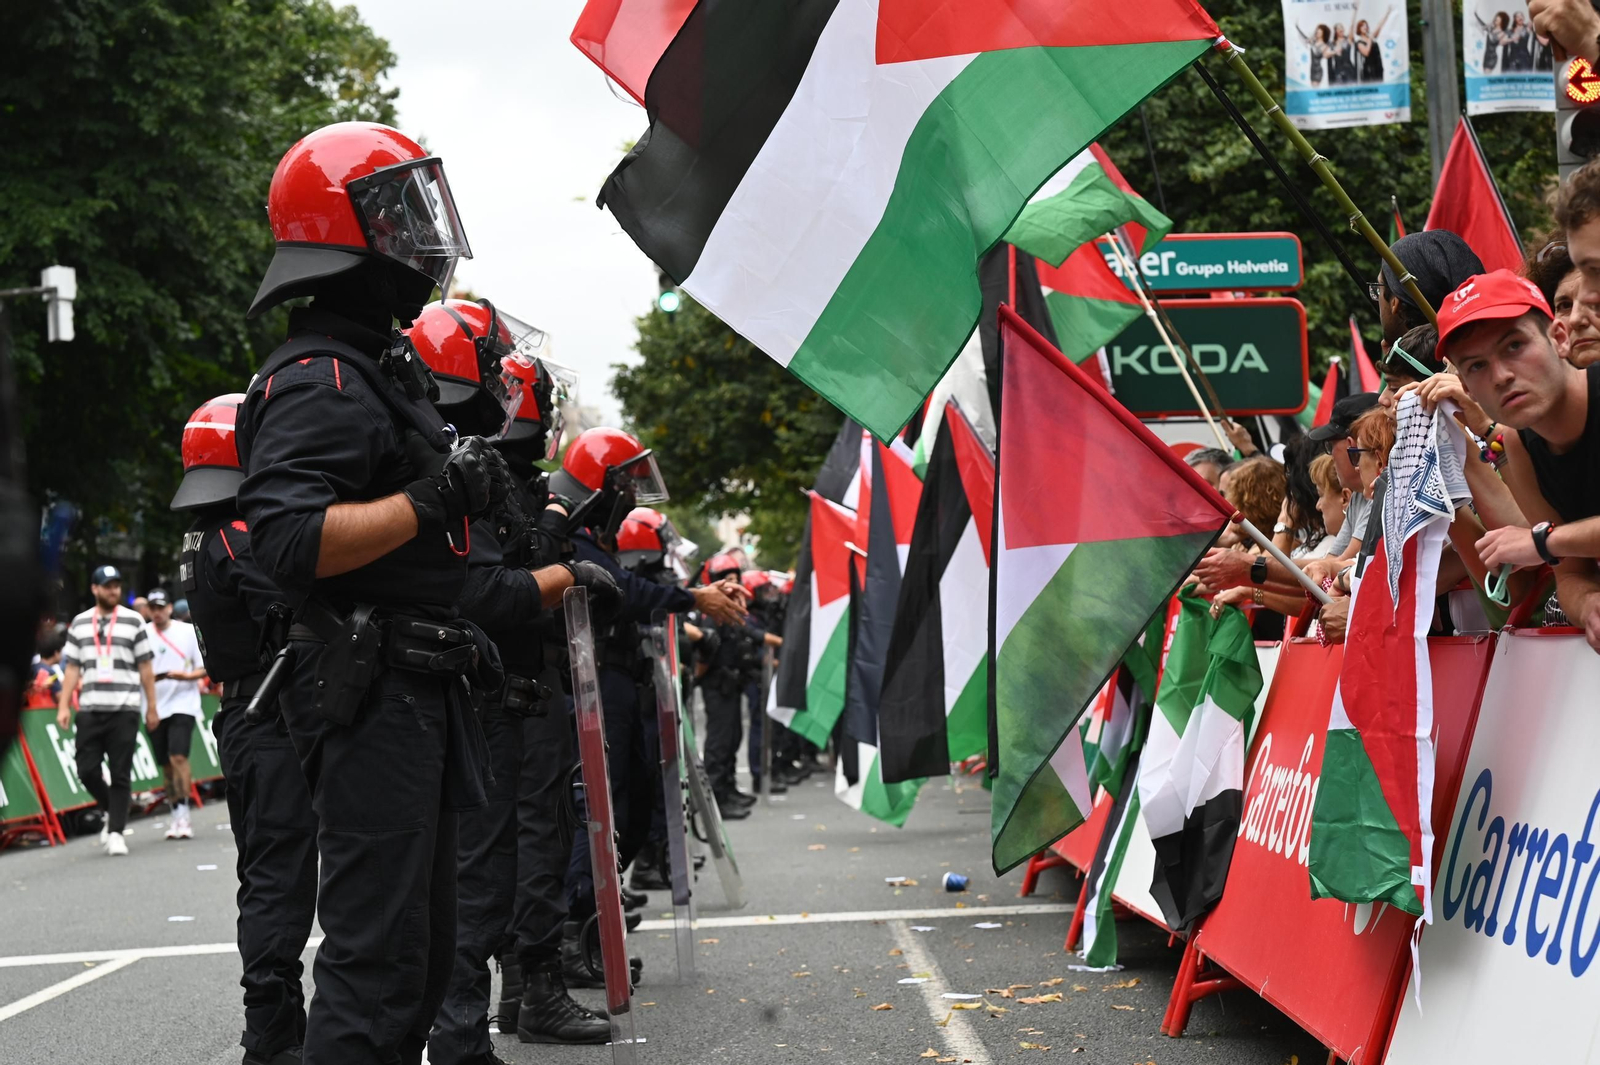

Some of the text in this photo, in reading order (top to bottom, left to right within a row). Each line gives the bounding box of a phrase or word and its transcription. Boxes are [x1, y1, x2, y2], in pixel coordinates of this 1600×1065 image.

[1175, 262, 1225, 278] Grupo
[1227, 259, 1289, 273] Helvetia
[1112, 343, 1269, 375] KODA
